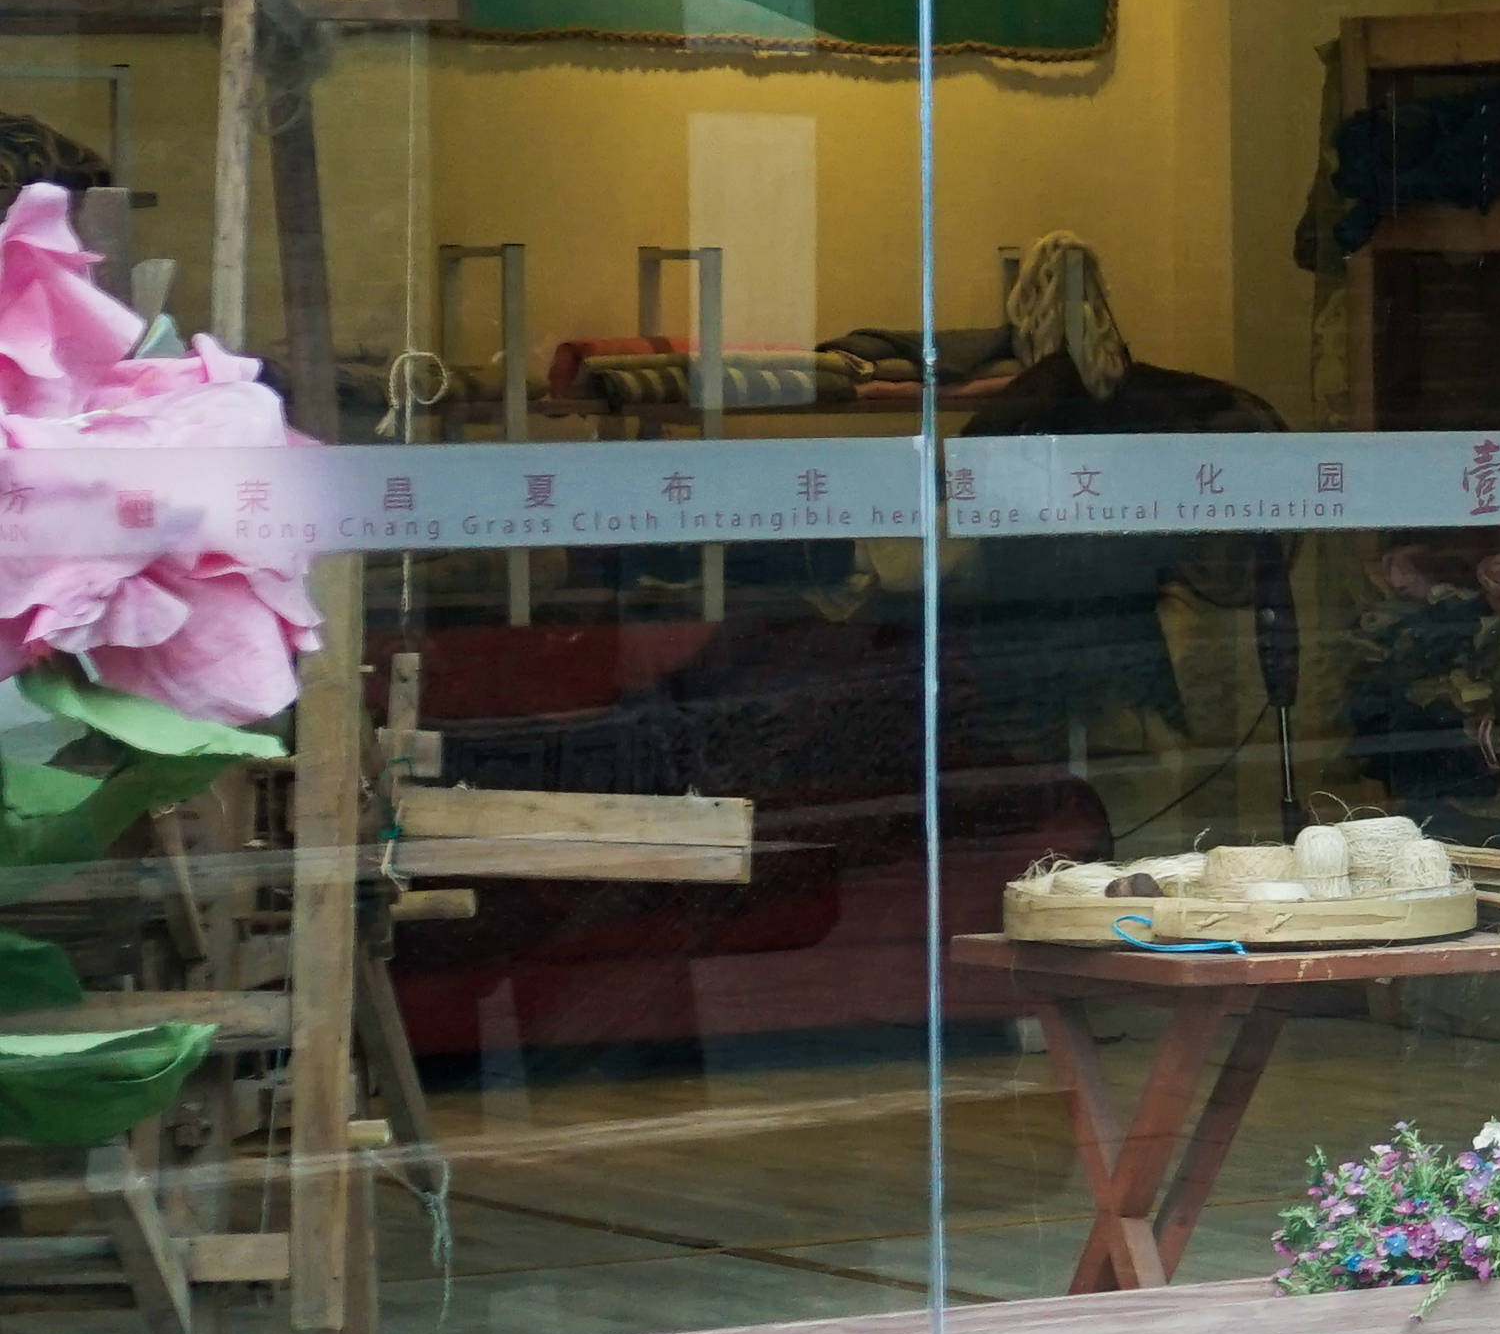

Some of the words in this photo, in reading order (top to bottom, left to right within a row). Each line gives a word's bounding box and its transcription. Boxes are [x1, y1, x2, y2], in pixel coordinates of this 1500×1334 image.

[235, 518, 316, 545] Rong
[338, 514, 440, 542] Chang
[462, 511, 550, 534] Grass
[572, 510, 658, 531] Cloth
[680, 506, 851, 533] Intangible
[1039, 501, 1157, 522] cultural
[1178, 497, 1343, 519] translation
